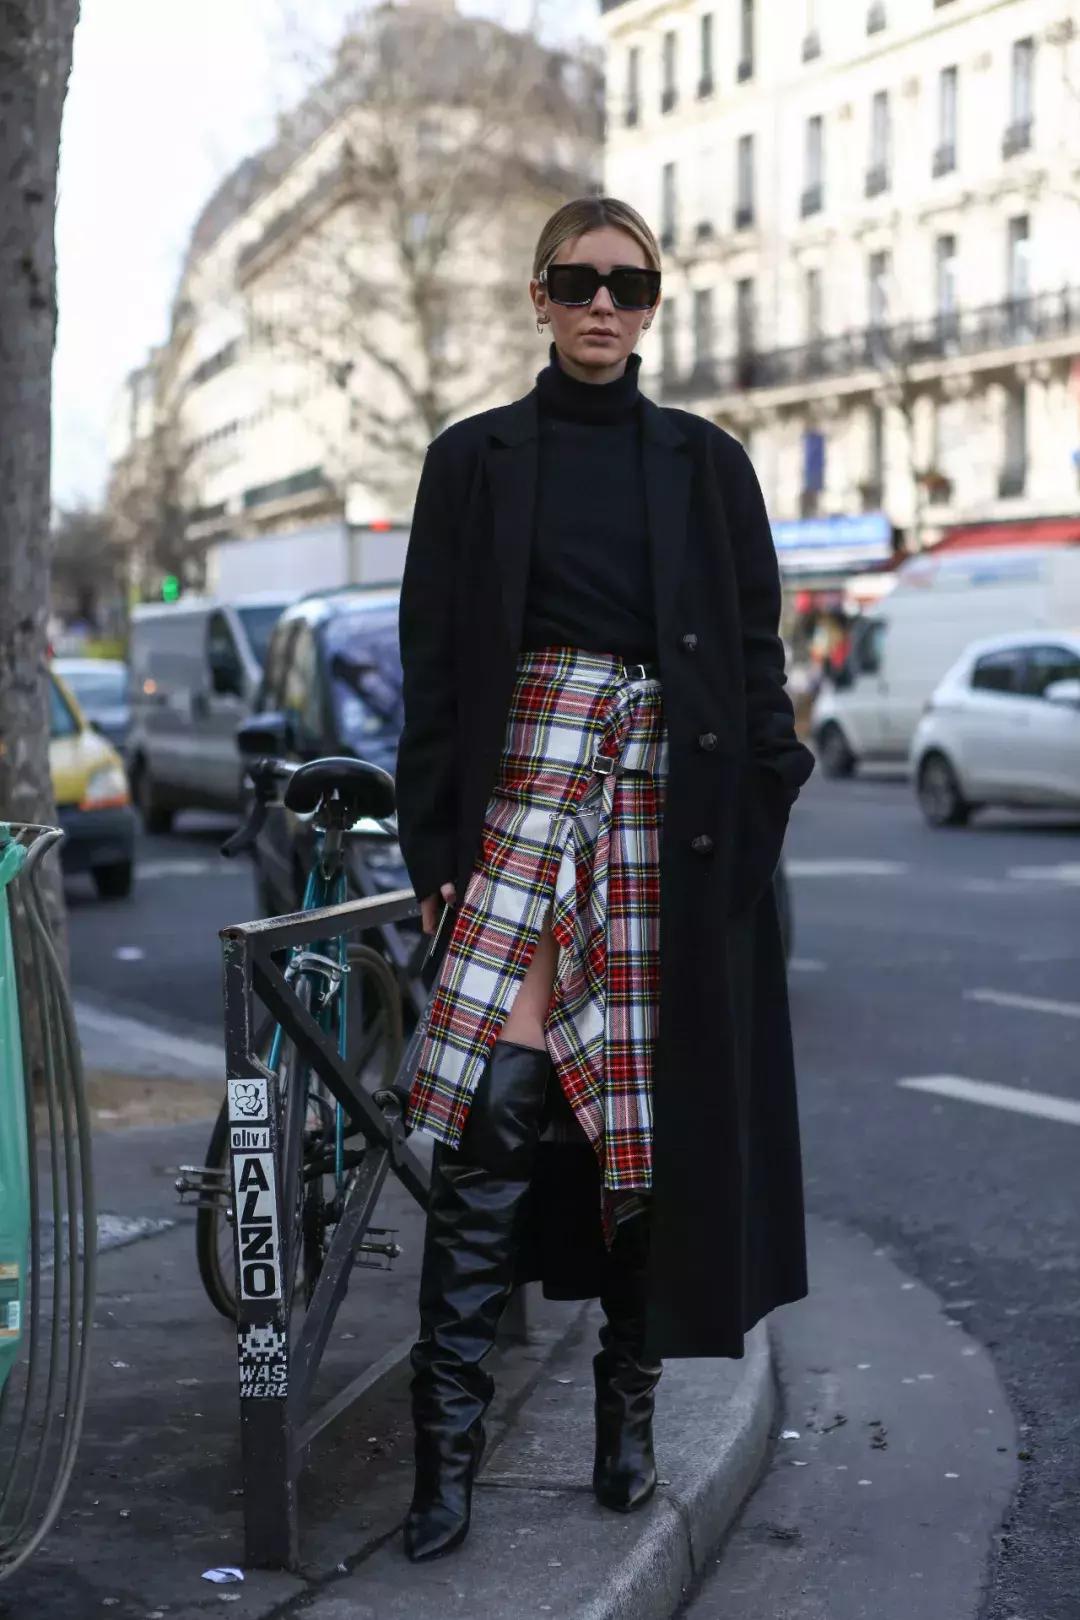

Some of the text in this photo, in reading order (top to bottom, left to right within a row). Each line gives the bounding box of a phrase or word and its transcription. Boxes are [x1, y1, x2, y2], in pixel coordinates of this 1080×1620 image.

[238, 1158, 276, 1298] ALZO
[239, 1364, 288, 1382] WAS
[239, 1383, 288, 1397] HERE
